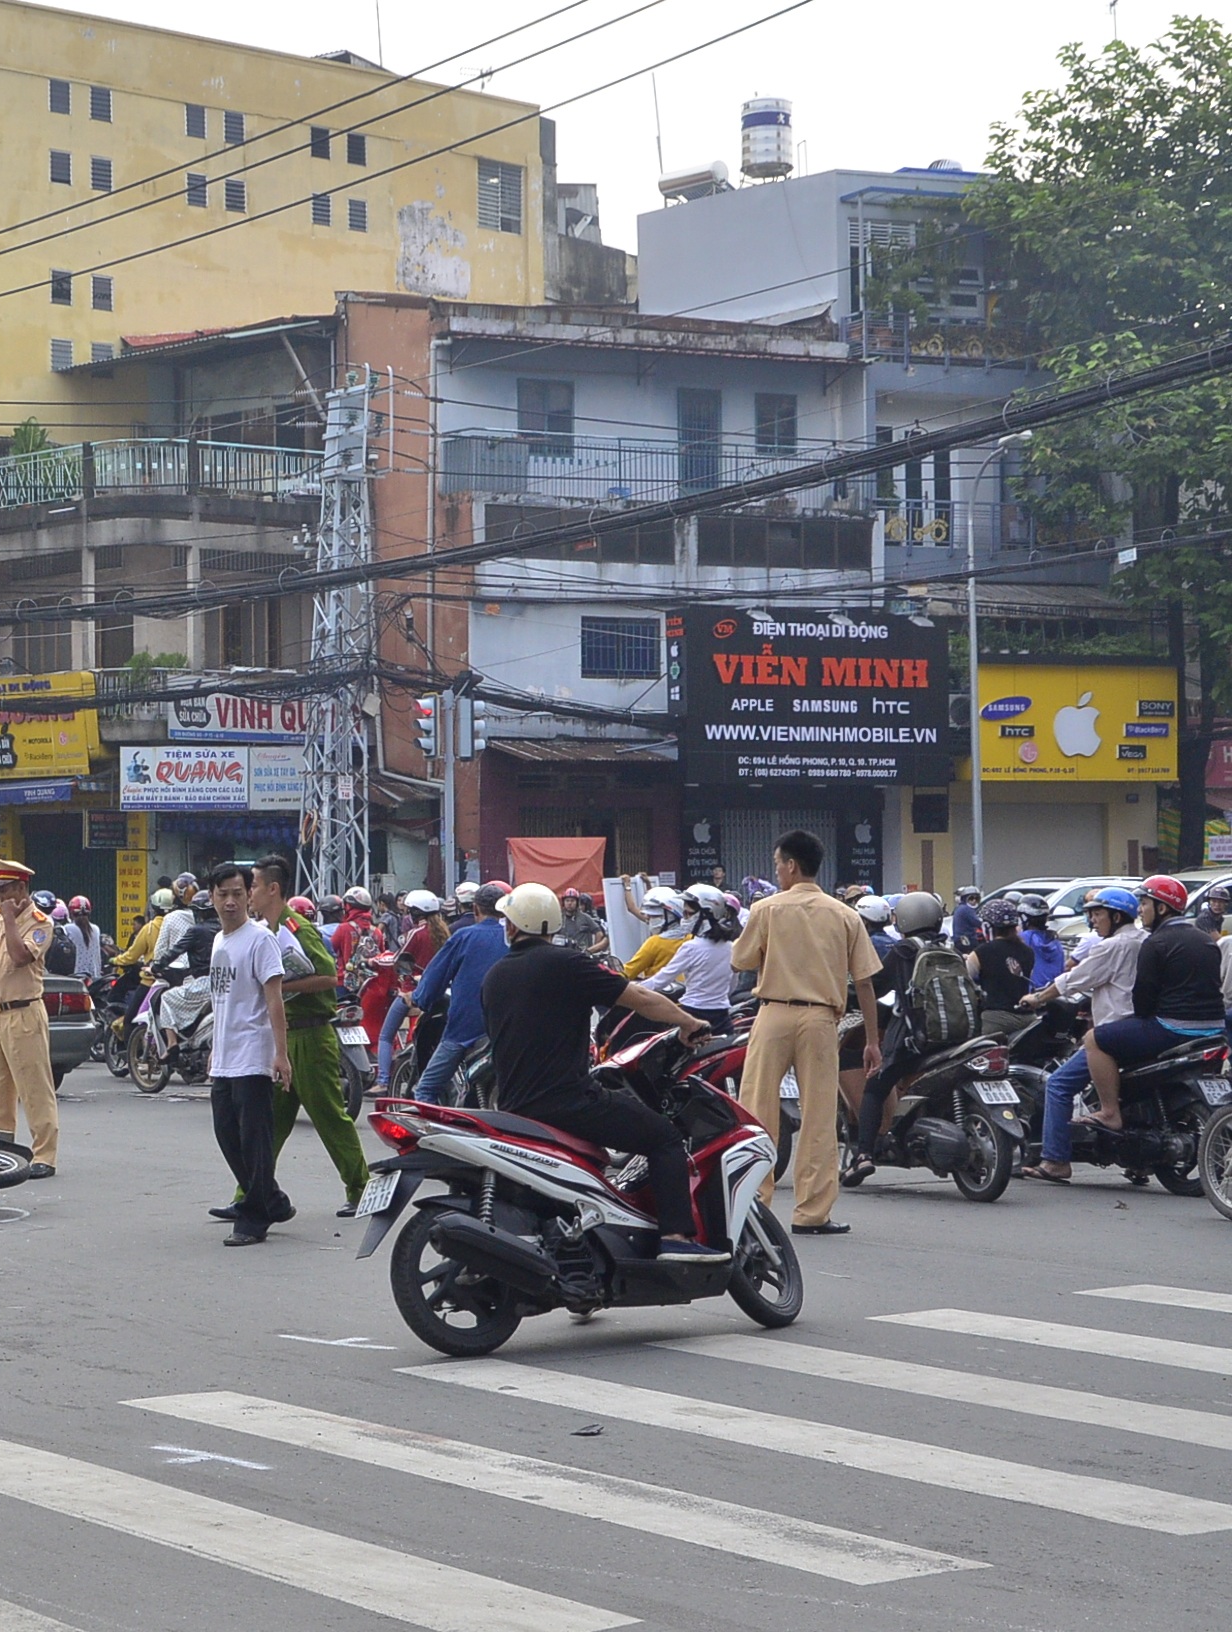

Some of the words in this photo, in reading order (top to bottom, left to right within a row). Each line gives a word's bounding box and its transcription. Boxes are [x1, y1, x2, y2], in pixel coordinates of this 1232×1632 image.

[753, 621, 785, 640] ĐIỆN
[788, 622, 830, 641] THOẠI
[832, 624, 846, 637] DI
[848, 621, 888, 642] ĐỘNG
[712, 643, 808, 686] VIỄN
[821, 656, 929, 688] MINH
[731, 698, 774, 712] APPLE
[792, 699, 858, 713] SAMSUNG
[987, 703, 1026, 712] SAMSUNG
[1140, 701, 1173, 711] SONY
[215, 697, 273, 730] VINH
[704, 723, 937, 743] WWW.VIENMINHMOBILE.VN
[1004, 726, 1030, 736] htc
[164, 750, 192, 760] TIỆM
[195, 748, 217, 759] SỬA
[220, 750, 235, 758] XE
[767, 755, 777, 765] LÊ
[778, 753, 801, 766] HỒNG
[155, 760, 245, 786] QUANG
[218, 785, 230, 793] CÁC
[210, 966, 237, 981] RBAN
